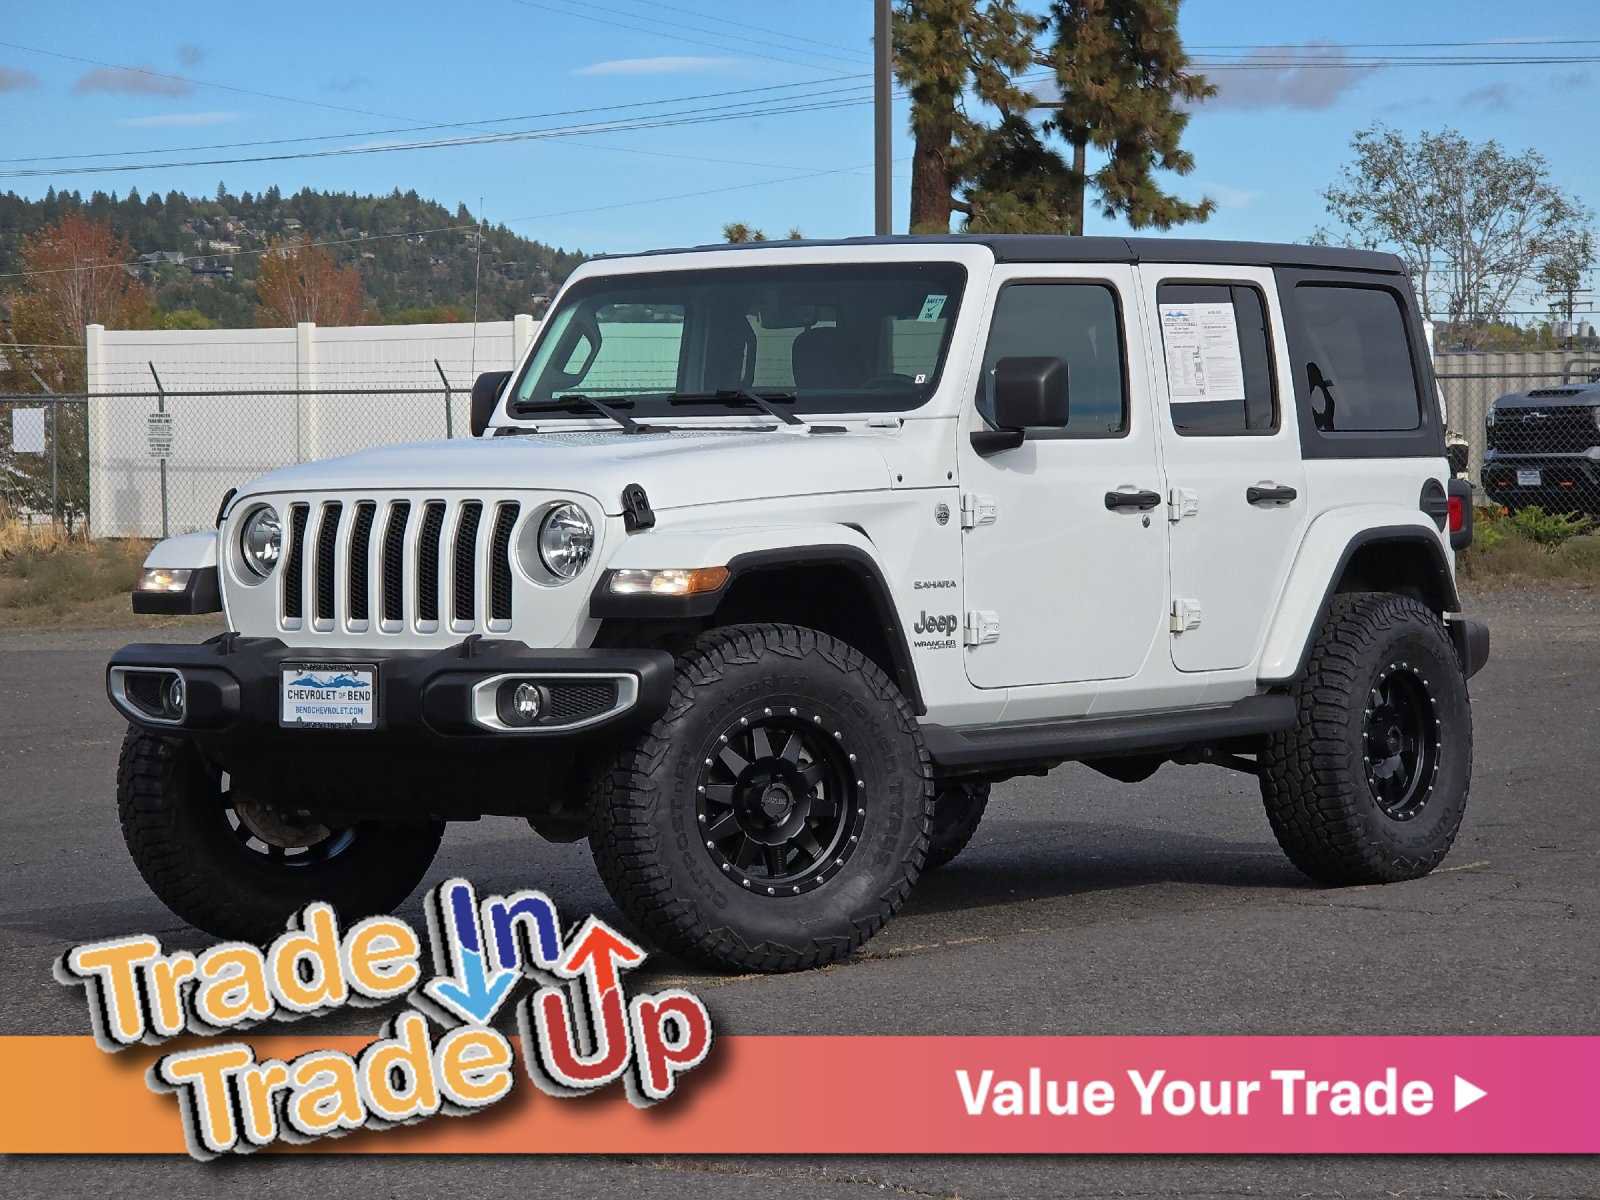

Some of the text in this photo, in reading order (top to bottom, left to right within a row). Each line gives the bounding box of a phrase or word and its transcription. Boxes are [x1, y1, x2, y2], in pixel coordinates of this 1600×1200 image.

[913, 580, 957, 589] SAHARA
[913, 610, 957, 637] Jeep
[913, 640, 956, 648] WRANGLER
[287, 689, 336, 700] CHEVROLET
[347, 691, 371, 701] BEND
[295, 706, 363, 715] BENDCHEVROLET.COM
